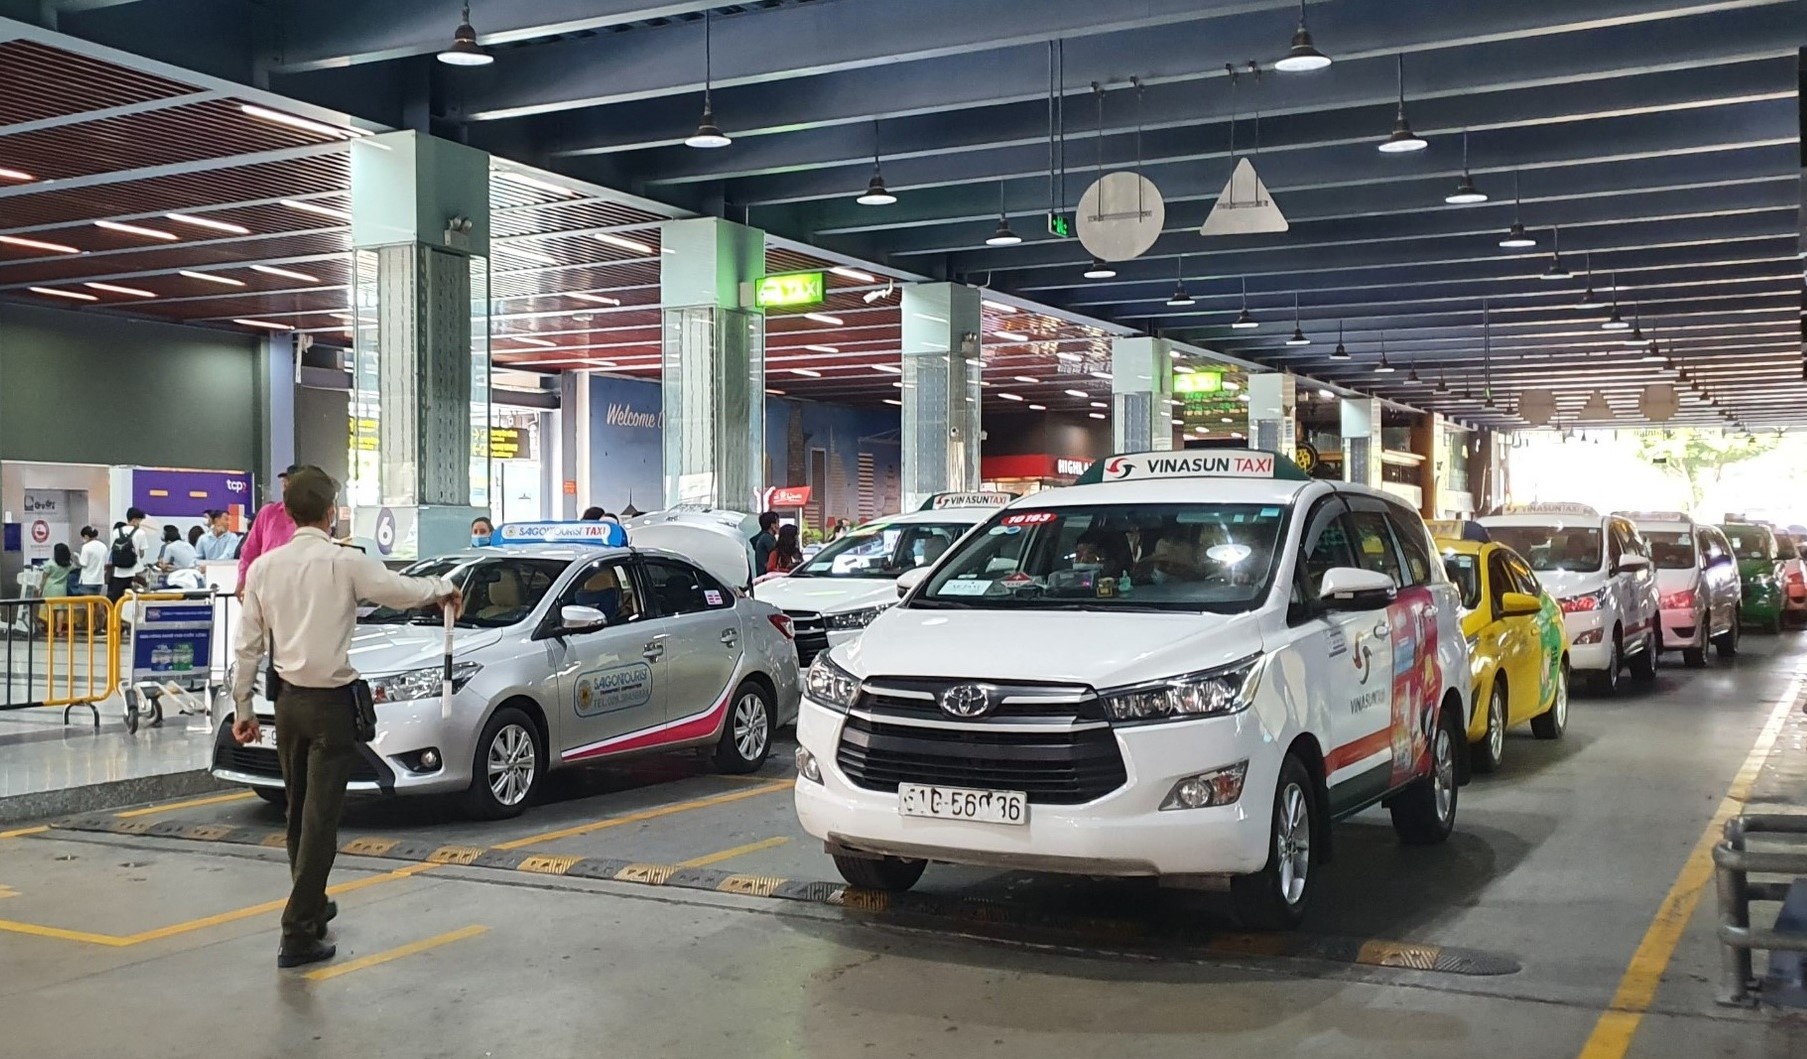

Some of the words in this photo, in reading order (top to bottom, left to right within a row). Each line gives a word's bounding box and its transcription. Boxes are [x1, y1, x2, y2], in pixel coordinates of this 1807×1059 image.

[606, 403, 656, 428] Welcome
[1058, 459, 1092, 476] HIGHLA
[1147, 457, 1229, 473] VINASUN
[1234, 457, 1272, 473] TAXI
[378, 516, 393, 546] 6
[585, 526, 606, 536] TAXI
